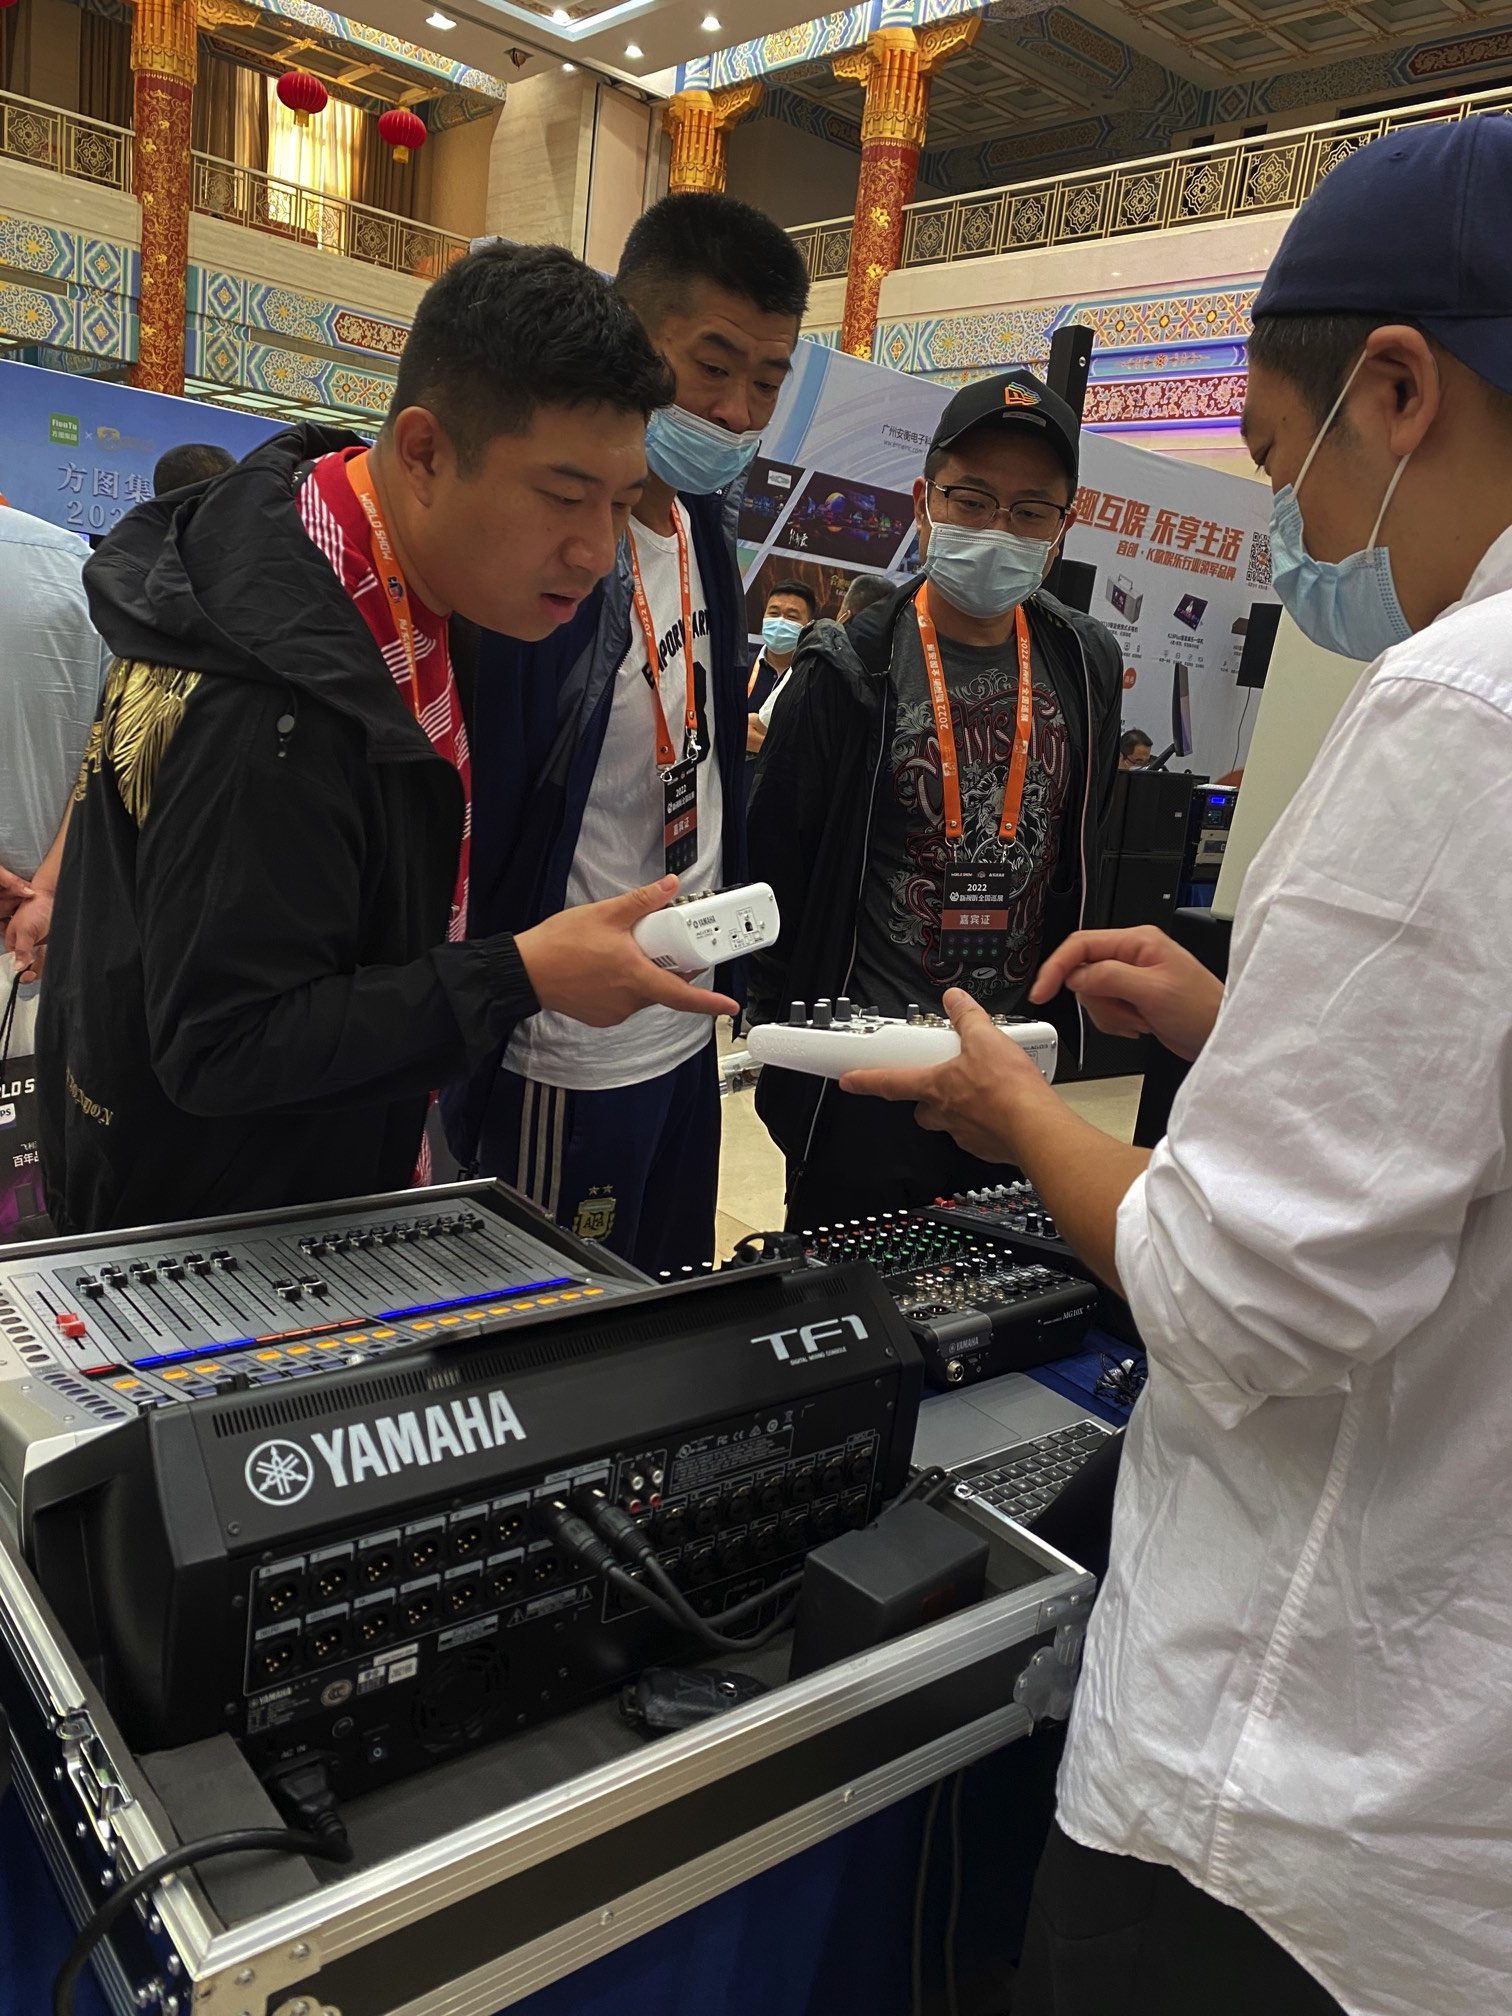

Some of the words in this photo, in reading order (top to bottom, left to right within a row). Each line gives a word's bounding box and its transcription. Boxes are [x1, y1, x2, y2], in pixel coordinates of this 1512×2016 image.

[359, 492, 383, 529] WORLD
[373, 526, 393, 561] SHOW
[1150, 508, 1245, 562] 乐享生活
[1020, 636, 1030, 656] 2022
[935, 704, 950, 730] 2022
[967, 883, 988, 892] 2022
[959, 914, 991, 926] 嘉宾证
[0, 1080, 21, 1099] LD
[750, 1314, 869, 1361] TF1
[956, 1336, 979, 1351] YAMAHA
[310, 1390, 527, 1488] YAMAHA
[259, 1686, 292, 1705] YAMAHA
